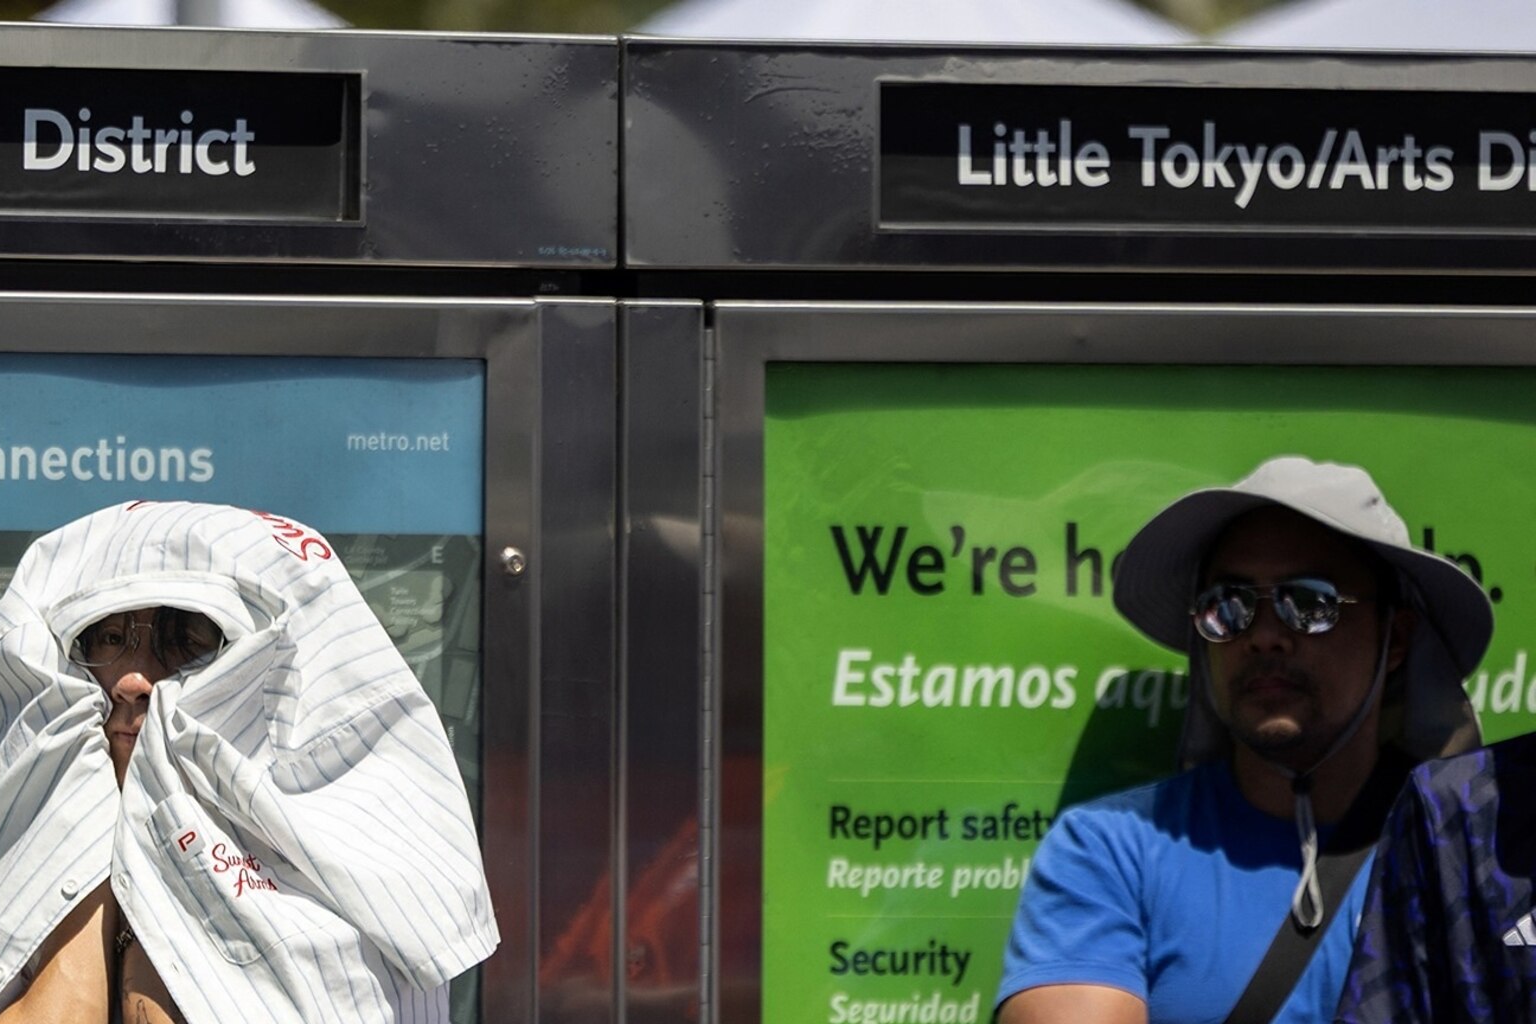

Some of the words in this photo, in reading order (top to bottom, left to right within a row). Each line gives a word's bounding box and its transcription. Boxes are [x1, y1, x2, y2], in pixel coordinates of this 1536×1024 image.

[24, 108, 256, 177] District
[959, 119, 1111, 187] Little
[1128, 122, 1455, 209] Tokyo/Arts
[347, 431, 450, 451] metro.net
[431, 546, 444, 563] E
[830, 647, 1079, 709] Estamos
[829, 804, 949, 850] Report
[826, 858, 944, 898] Reporte
[950, 857, 1031, 898] probl
[829, 939, 972, 987] Security
